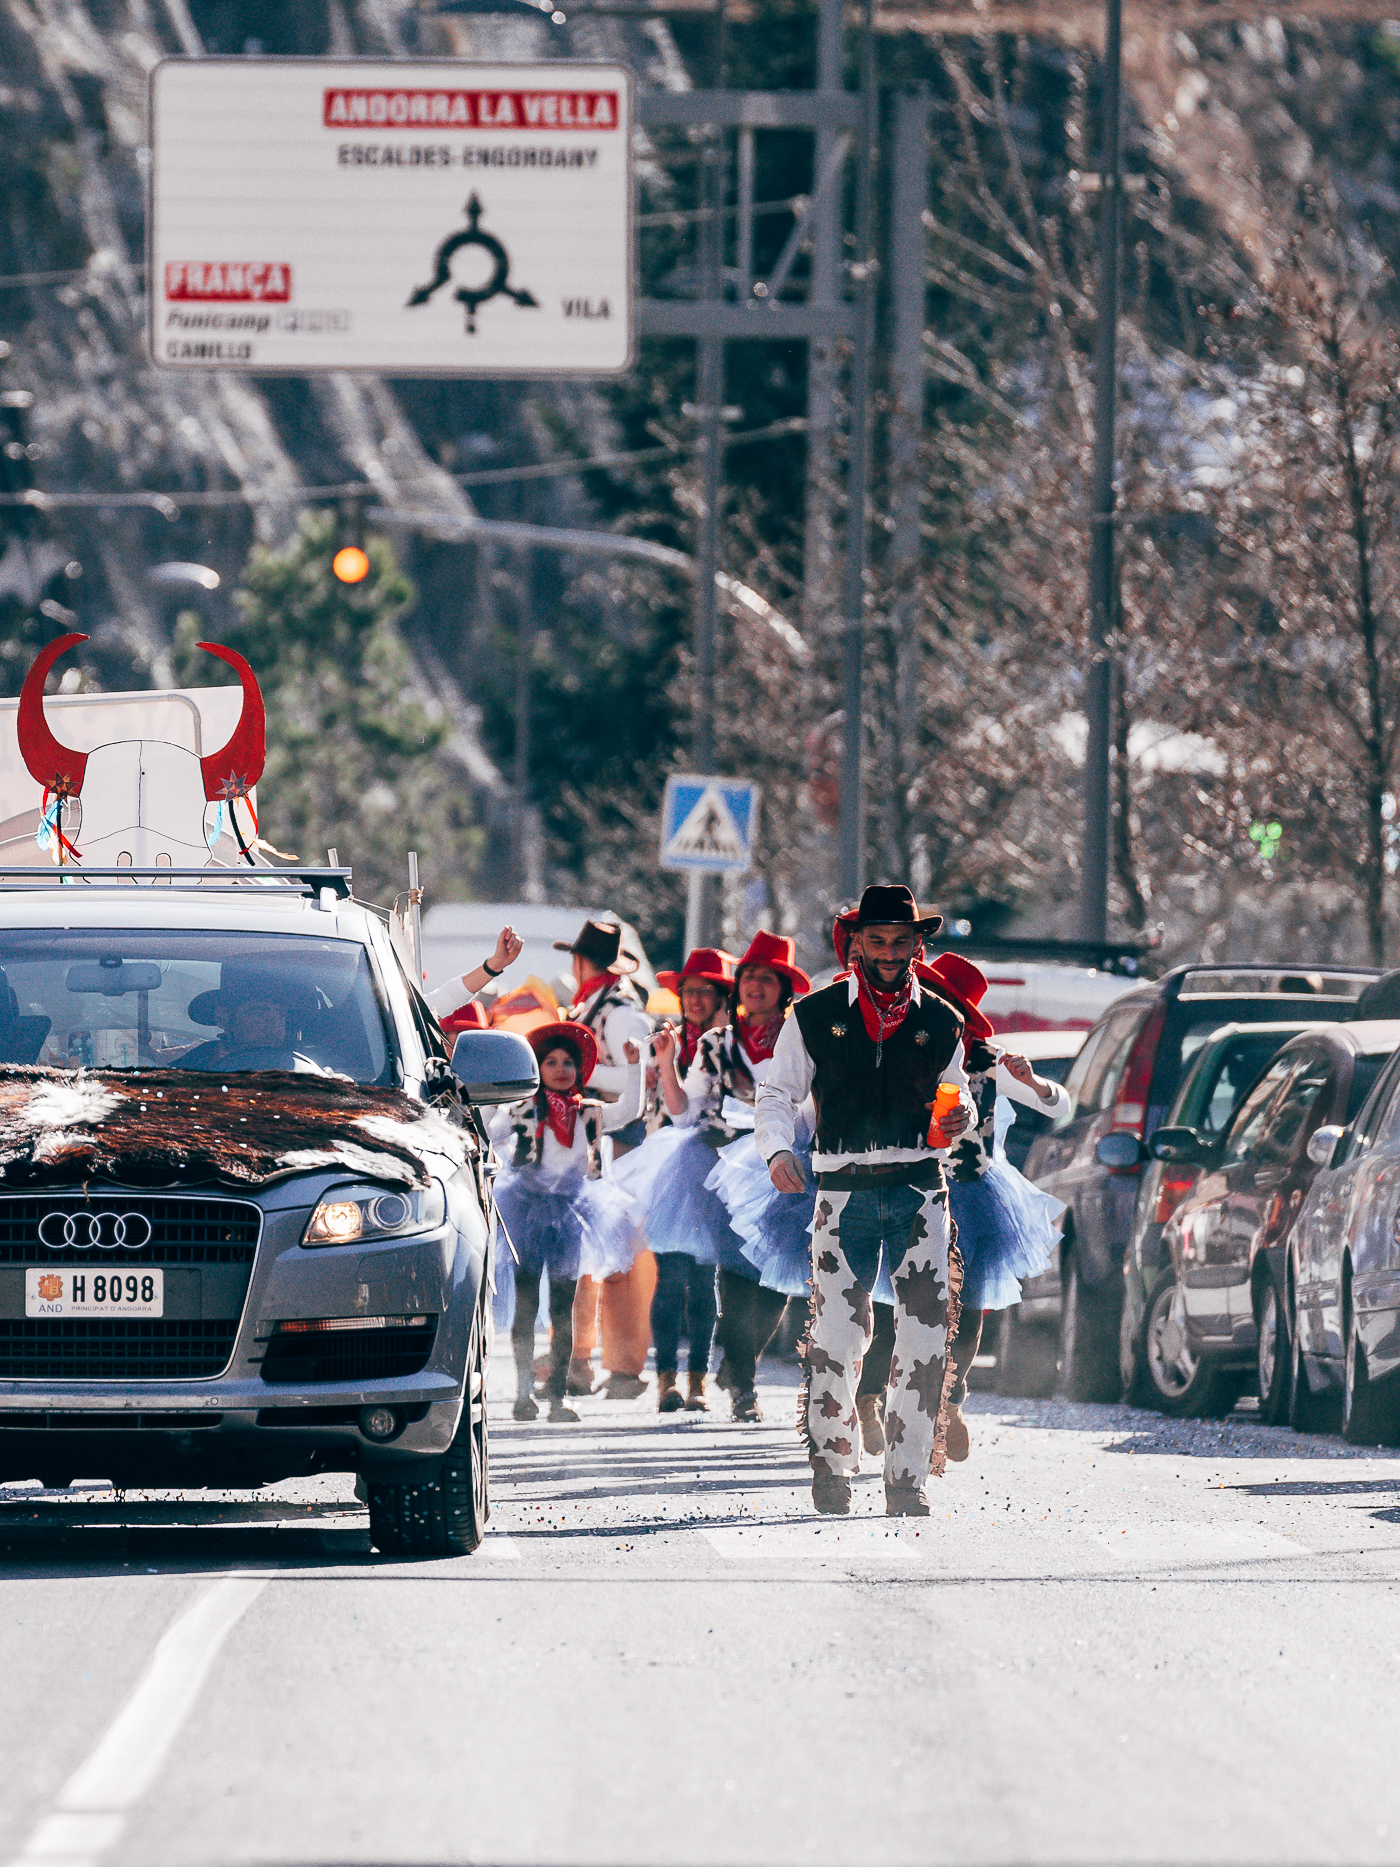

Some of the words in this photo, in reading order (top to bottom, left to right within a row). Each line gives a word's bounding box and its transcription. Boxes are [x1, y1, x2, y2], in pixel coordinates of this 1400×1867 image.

[331, 94, 471, 123] ANDORRA
[480, 95, 515, 123] LA
[525, 96, 613, 124] VELLA
[169, 263, 285, 298] FRANÇA
[561, 299, 611, 320] VILA
[72, 1275, 85, 1302] H
[94, 1275, 154, 1302] 8098
[38, 1304, 63, 1313] AND
